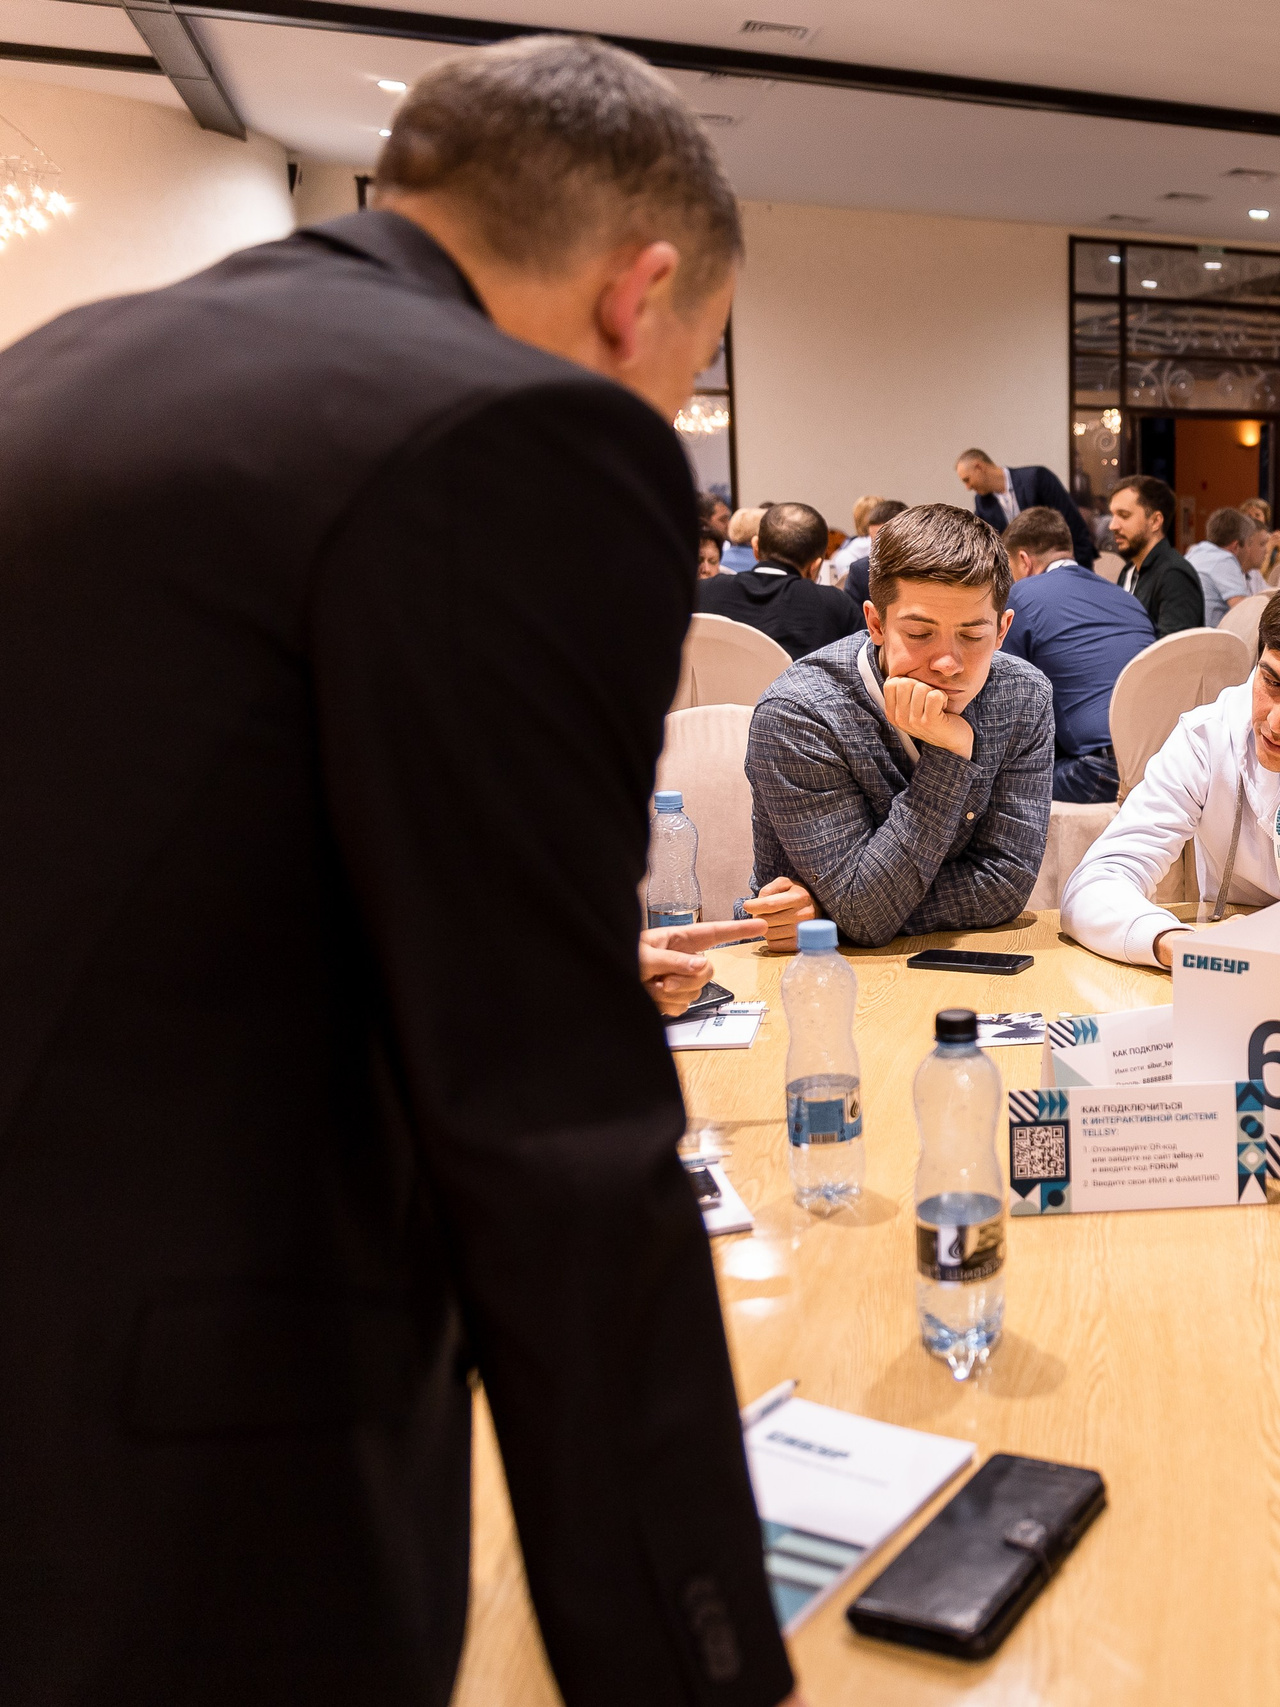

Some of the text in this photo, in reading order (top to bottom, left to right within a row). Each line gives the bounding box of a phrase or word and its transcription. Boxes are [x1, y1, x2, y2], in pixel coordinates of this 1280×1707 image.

[1182, 953, 1250, 974] СИБУР
[1112, 1041, 1173, 1058] КАК ПОДКЛЮЧИ
[1082, 1101, 1183, 1113] КАК ПОДКЛЮЧИТЬСЯ
[1082, 1111, 1218, 1125] К ИНТЕРАКТИВНОЙ СИСТЕМЕ
[1149, 1161, 1178, 1170] FORUM
